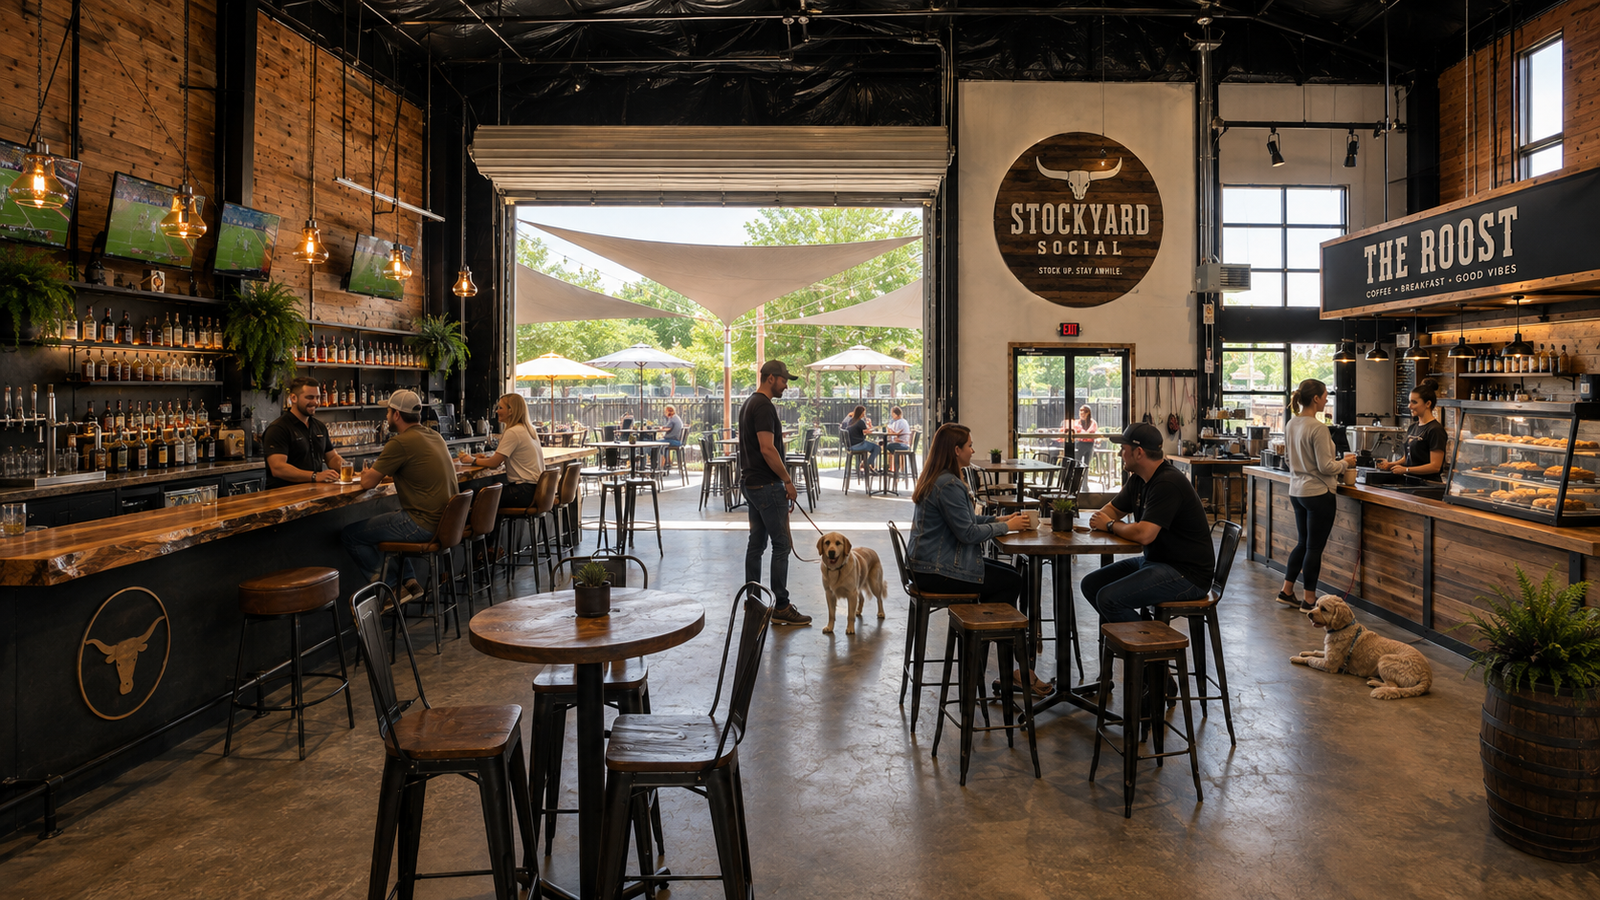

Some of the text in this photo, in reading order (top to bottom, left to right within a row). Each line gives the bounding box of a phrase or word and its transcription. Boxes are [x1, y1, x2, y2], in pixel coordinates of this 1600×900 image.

[1011, 203, 1150, 235] STOCKYARD
[1038, 241, 1122, 255] SOCIAL
[1364, 205, 1518, 284] THE ROOST
[1038, 266, 1123, 275] STOCK UP. STAY AWHILE.
[1366, 263, 1518, 298] COFFEE BREAKFAST GOOD VIBES
[1063, 324, 1077, 335] EXIT
